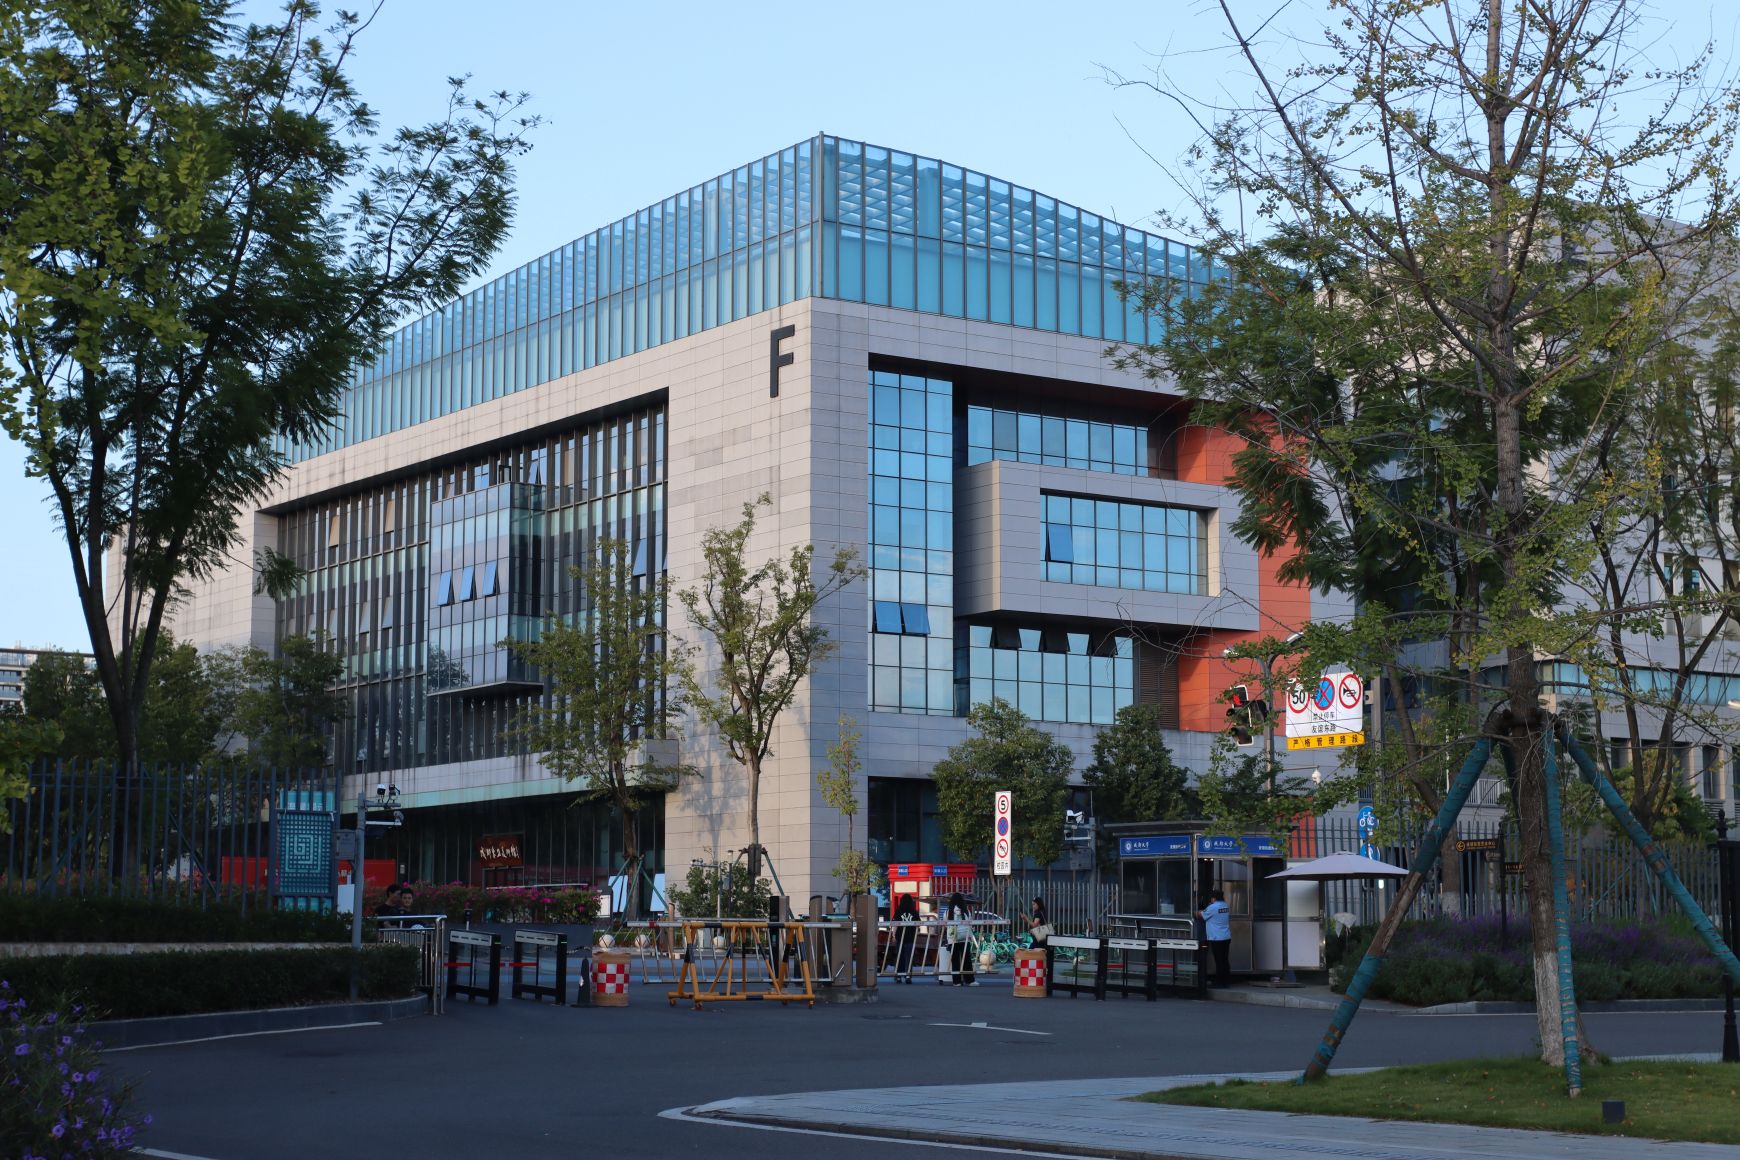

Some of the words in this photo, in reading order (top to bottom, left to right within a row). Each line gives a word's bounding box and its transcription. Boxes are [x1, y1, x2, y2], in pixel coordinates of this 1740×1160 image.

[770, 324, 795, 398] F
[1292, 690, 1305, 704] 50
[1292, 734, 1359, 749] 严格管理路段
[1000, 800, 1005, 810] 5
